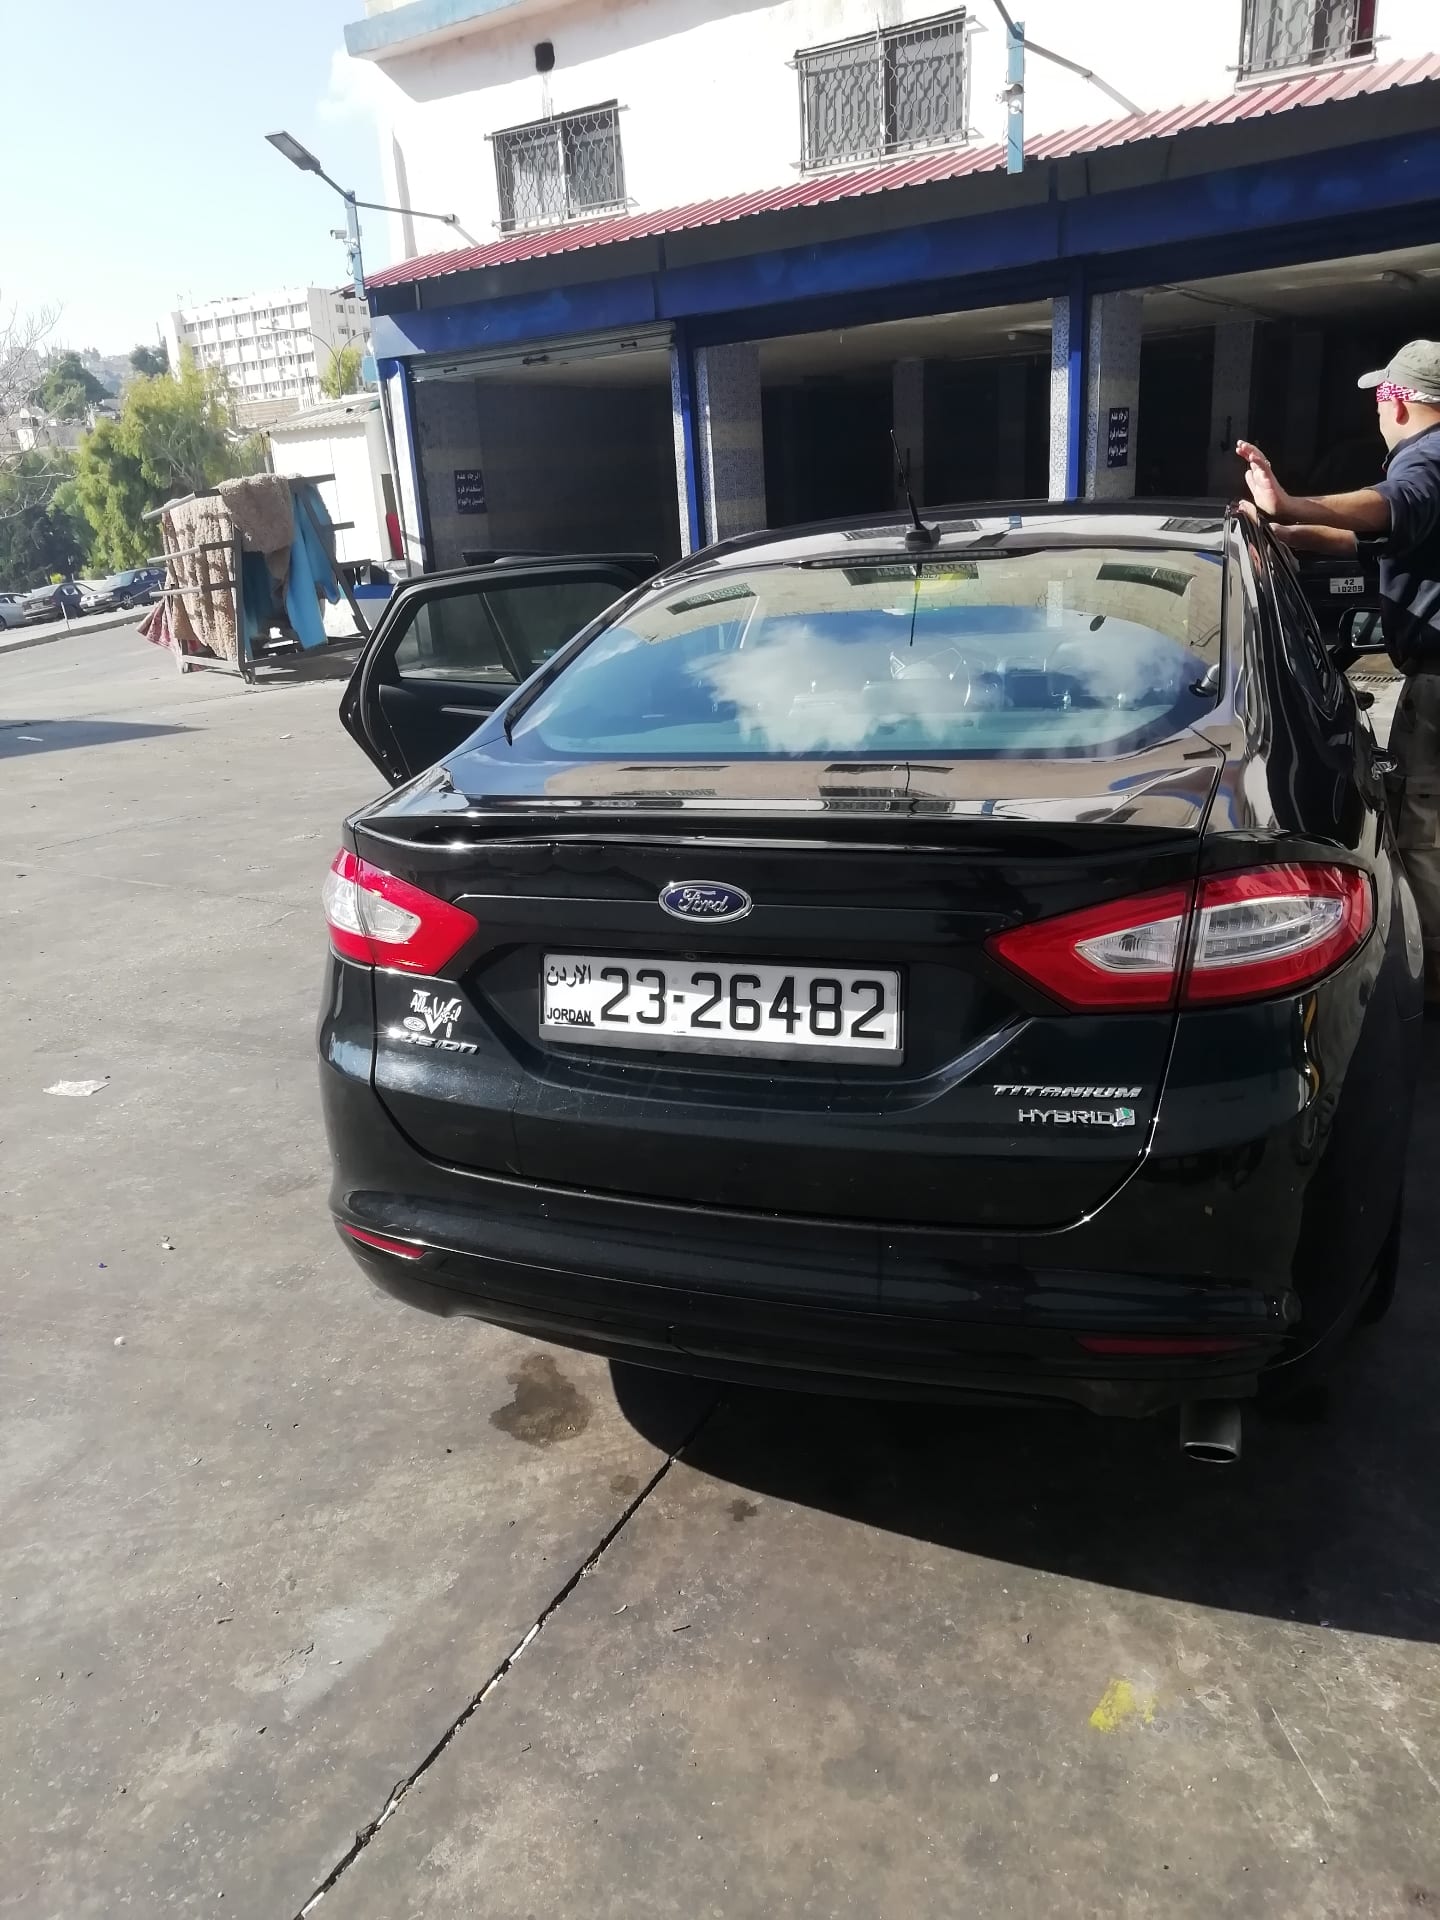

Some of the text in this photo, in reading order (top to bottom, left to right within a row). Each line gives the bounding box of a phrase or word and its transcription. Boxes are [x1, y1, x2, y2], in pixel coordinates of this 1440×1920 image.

[678, 888, 729, 913] Ford
[546, 1006, 592, 1024] JORDAN
[992, 1084, 1144, 1099] TITANIUM
[1018, 1108, 1115, 1126] HYBRID
